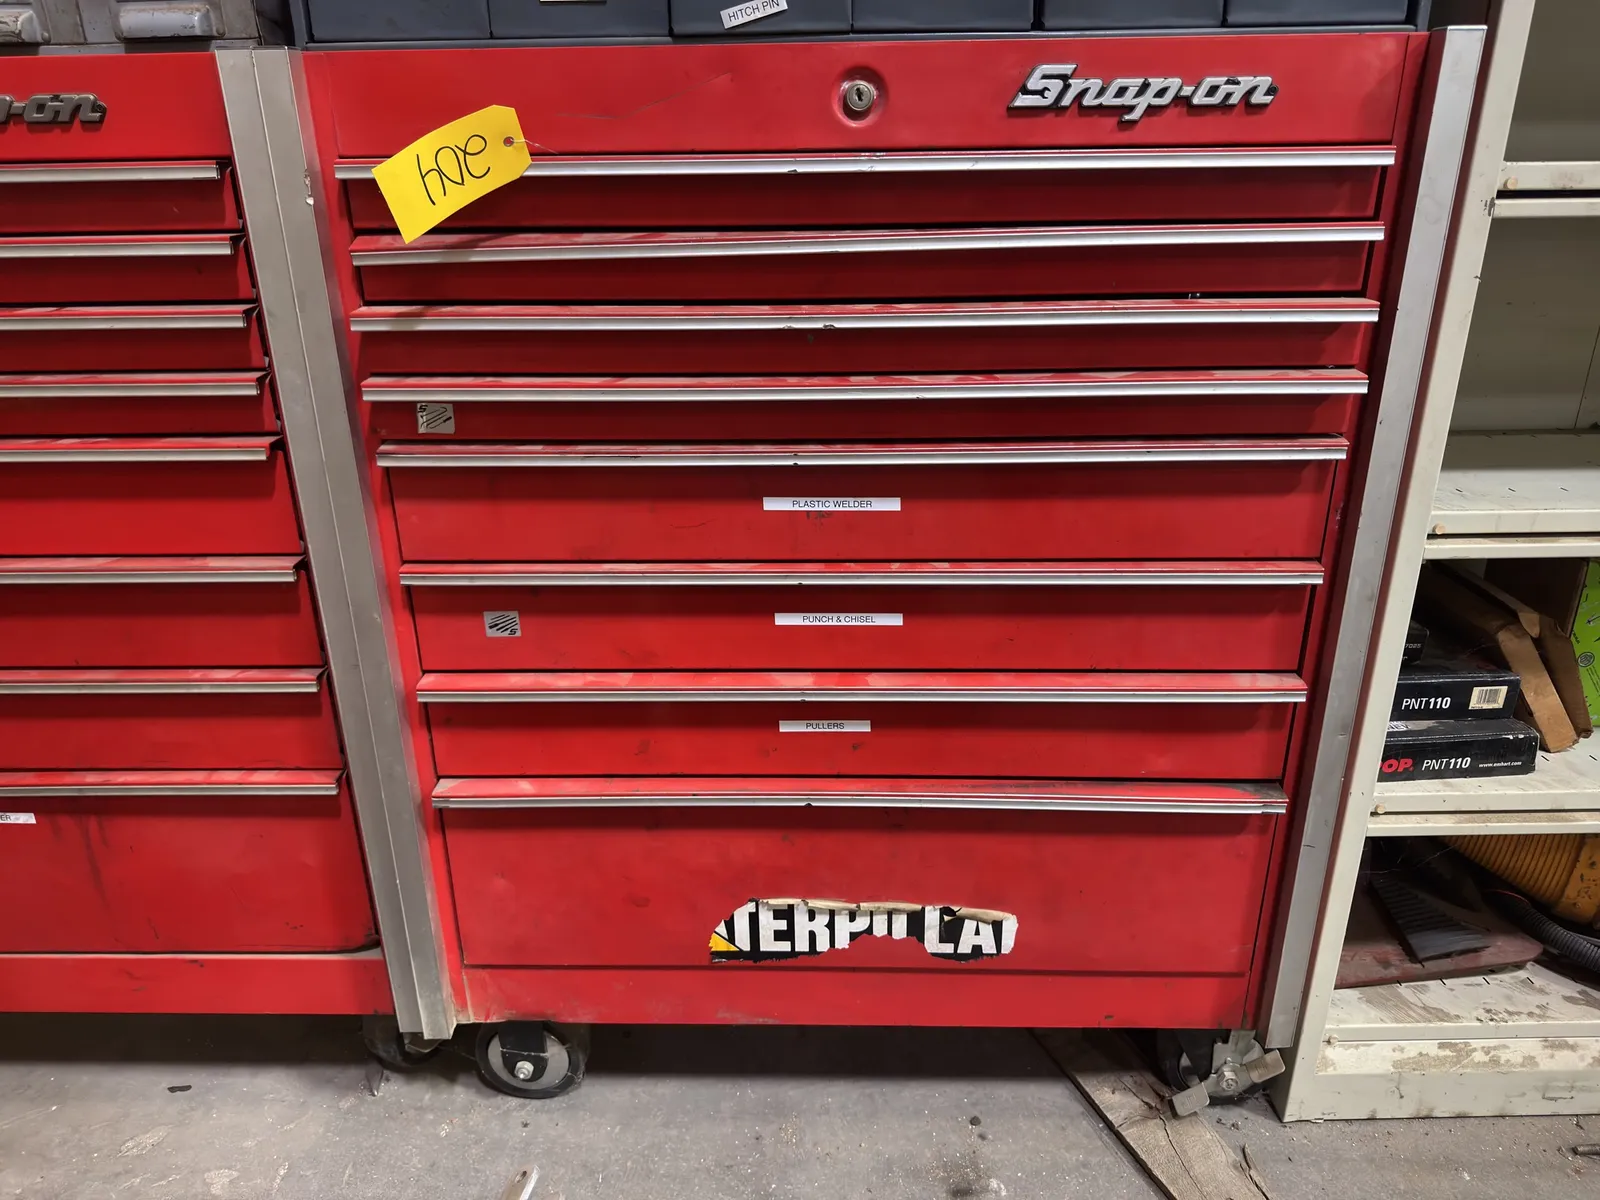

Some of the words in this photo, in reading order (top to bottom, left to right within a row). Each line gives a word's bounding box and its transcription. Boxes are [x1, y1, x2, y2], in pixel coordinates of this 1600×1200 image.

[727, 5, 760, 22] HITCH
[762, 0, 780, 12] PIN
[1007, 63, 1278, 123] Snap-on
[416, 134, 491, 206] 204
[792, 500, 831, 508] PLASTIC
[832, 500, 873, 508] WELDER
[802, 615, 834, 623] PUNCH
[835, 615, 842, 623] &
[844, 615, 876, 623] CHISEL
[1402, 697, 1451, 710] PNT110
[805, 722, 845, 730] PULLERS
[1422, 757, 1471, 771] PNT110
[0, 814, 12, 822] ER
